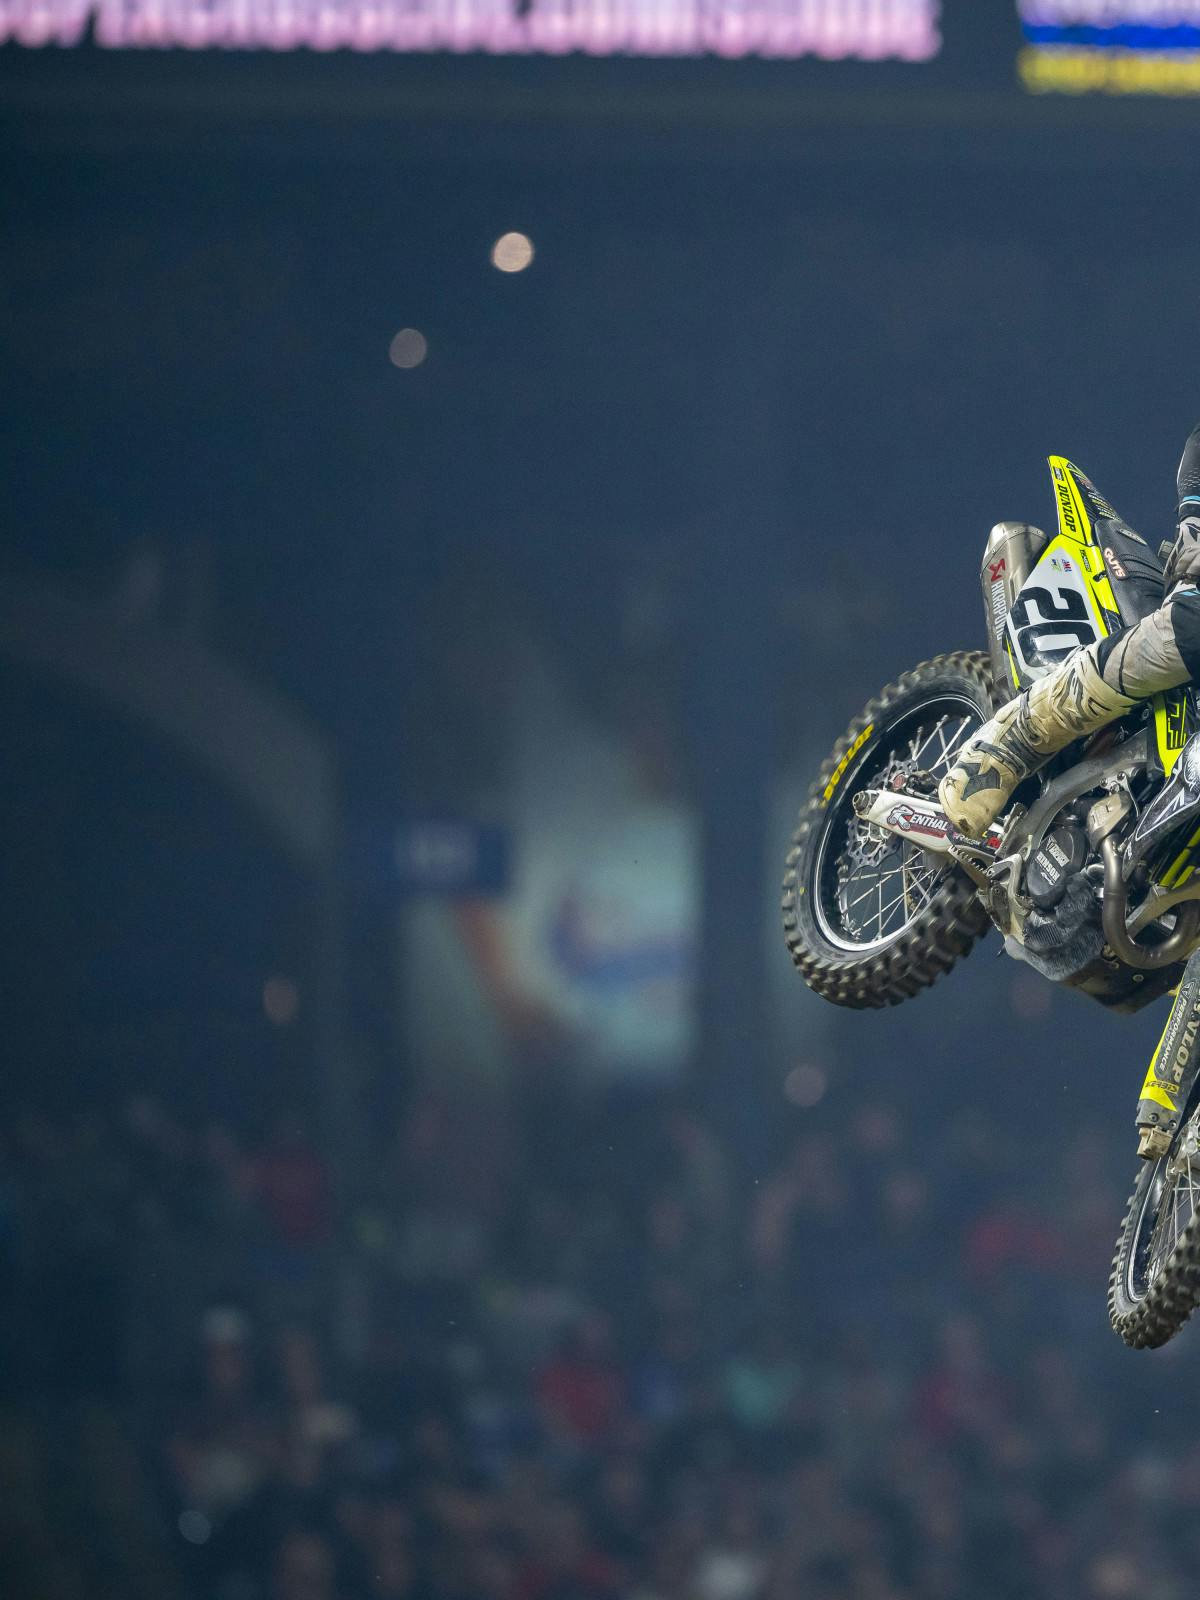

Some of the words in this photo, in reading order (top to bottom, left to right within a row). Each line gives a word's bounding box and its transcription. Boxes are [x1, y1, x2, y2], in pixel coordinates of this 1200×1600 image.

[1058, 484, 1076, 533] DUNLOP
[1104, 548, 1126, 577] GUTS
[1010, 586, 1097, 667] 20
[1159, 996, 1187, 1072] PERFORMANCE
